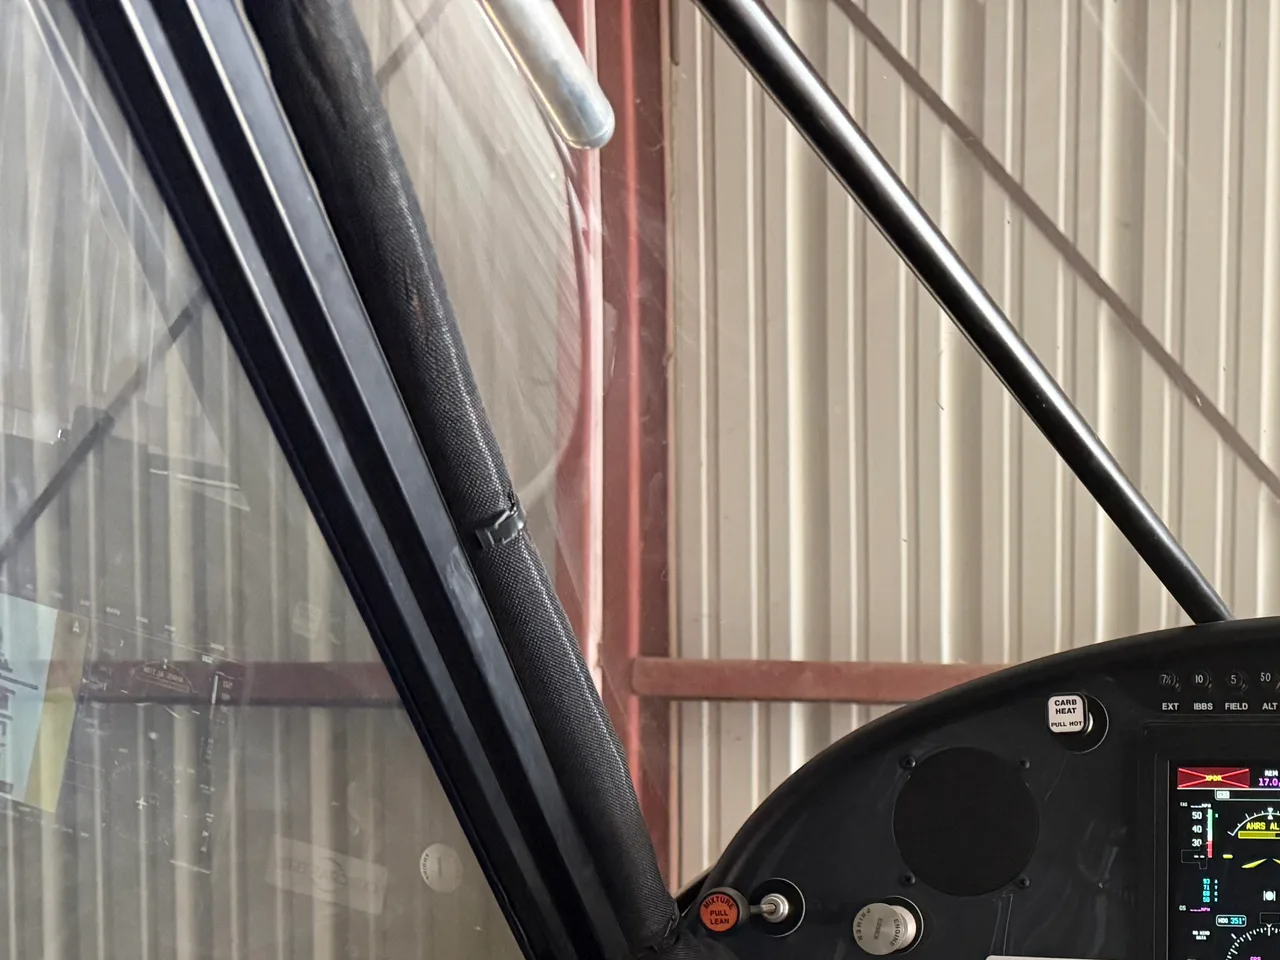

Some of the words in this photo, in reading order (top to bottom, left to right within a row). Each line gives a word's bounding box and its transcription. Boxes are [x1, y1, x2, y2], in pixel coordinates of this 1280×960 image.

[1195, 674, 1204, 684] 10
[1230, 674, 1237, 684] 5
[1260, 672, 1271, 682] 50
[1055, 707, 1077, 715] HEAT
[1161, 702, 1179, 711] EXT
[1193, 702, 1213, 711] IBBS
[1225, 702, 1248, 711] FIELD
[1261, 702, 1278, 711] ALT
[1192, 811, 1203, 820] 50
[1192, 825, 1203, 834] 40
[1246, 822, 1266, 830] AHRS
[1192, 839, 1203, 847] 30
[703, 895, 735, 910] MIXTURE
[710, 909, 729, 917] PULL
[889, 918, 901, 947] ENGINE
